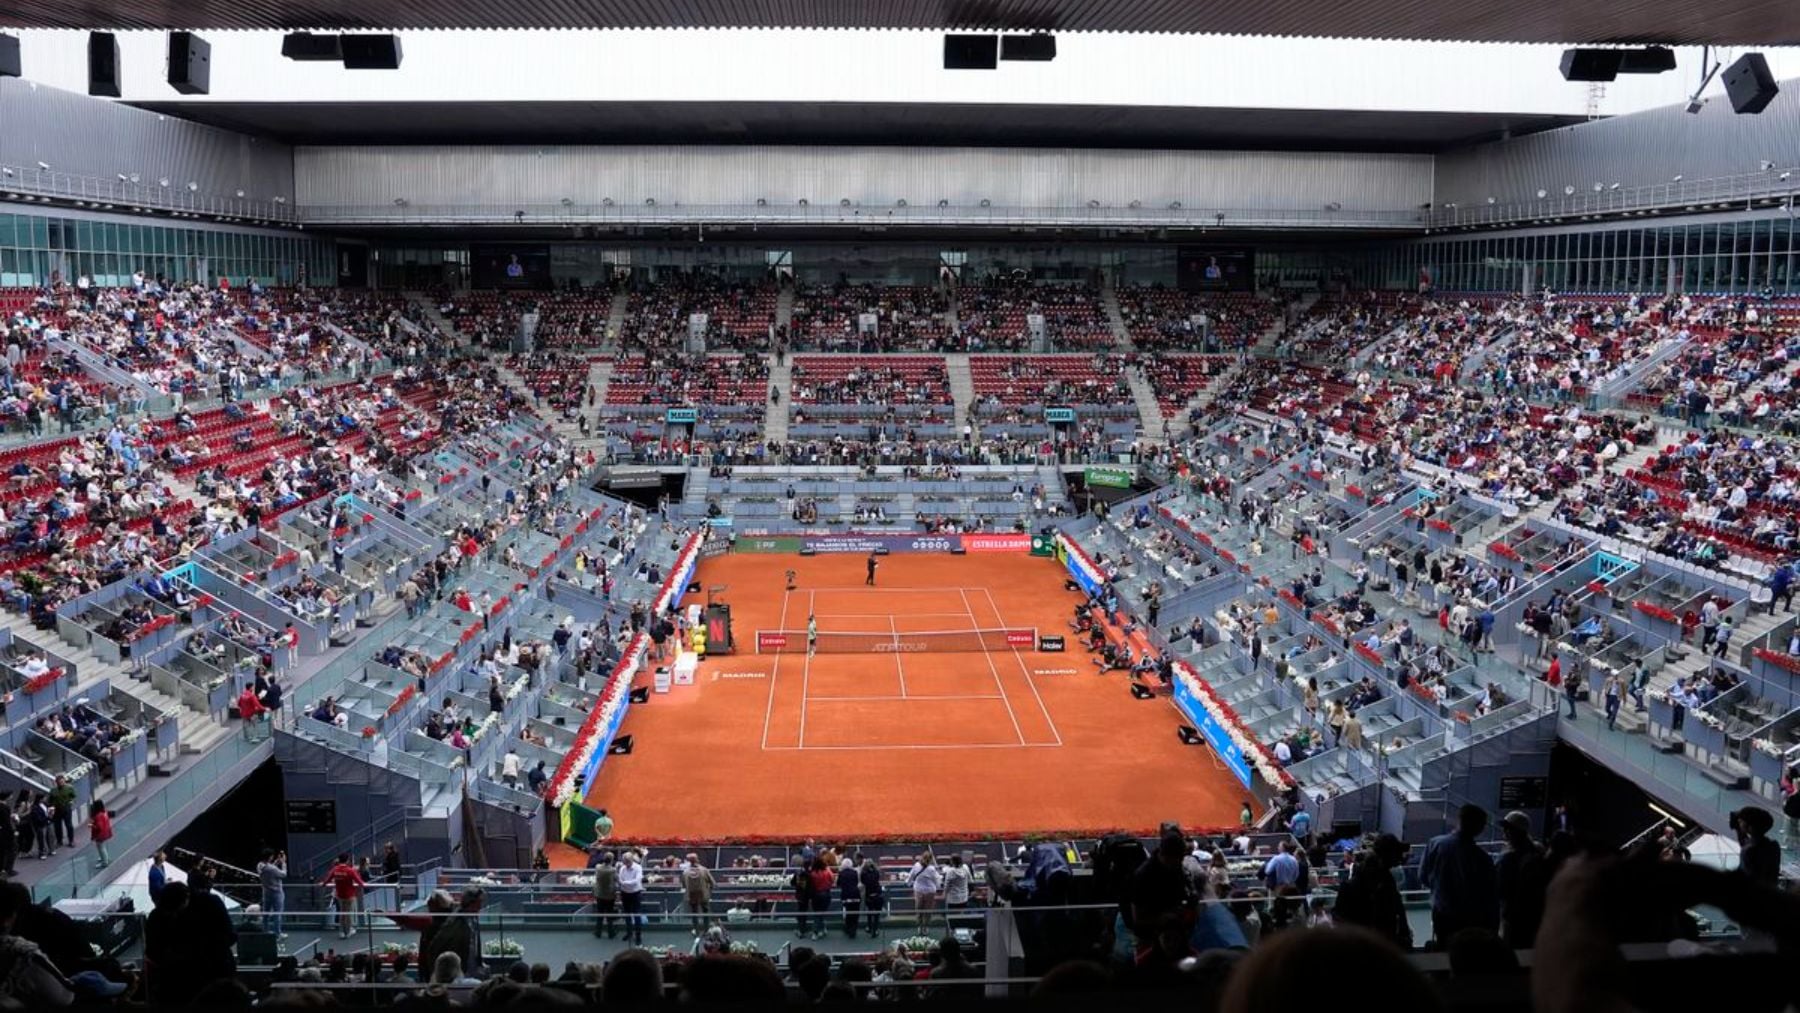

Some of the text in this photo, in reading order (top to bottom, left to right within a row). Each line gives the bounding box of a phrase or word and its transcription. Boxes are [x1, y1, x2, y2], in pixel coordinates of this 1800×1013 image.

[1046, 410, 1070, 418] MARCA
[1090, 472, 1123, 482] Europcar
[972, 540, 1006, 549] ESTRELLA
[1042, 642, 1062, 650] Haier
